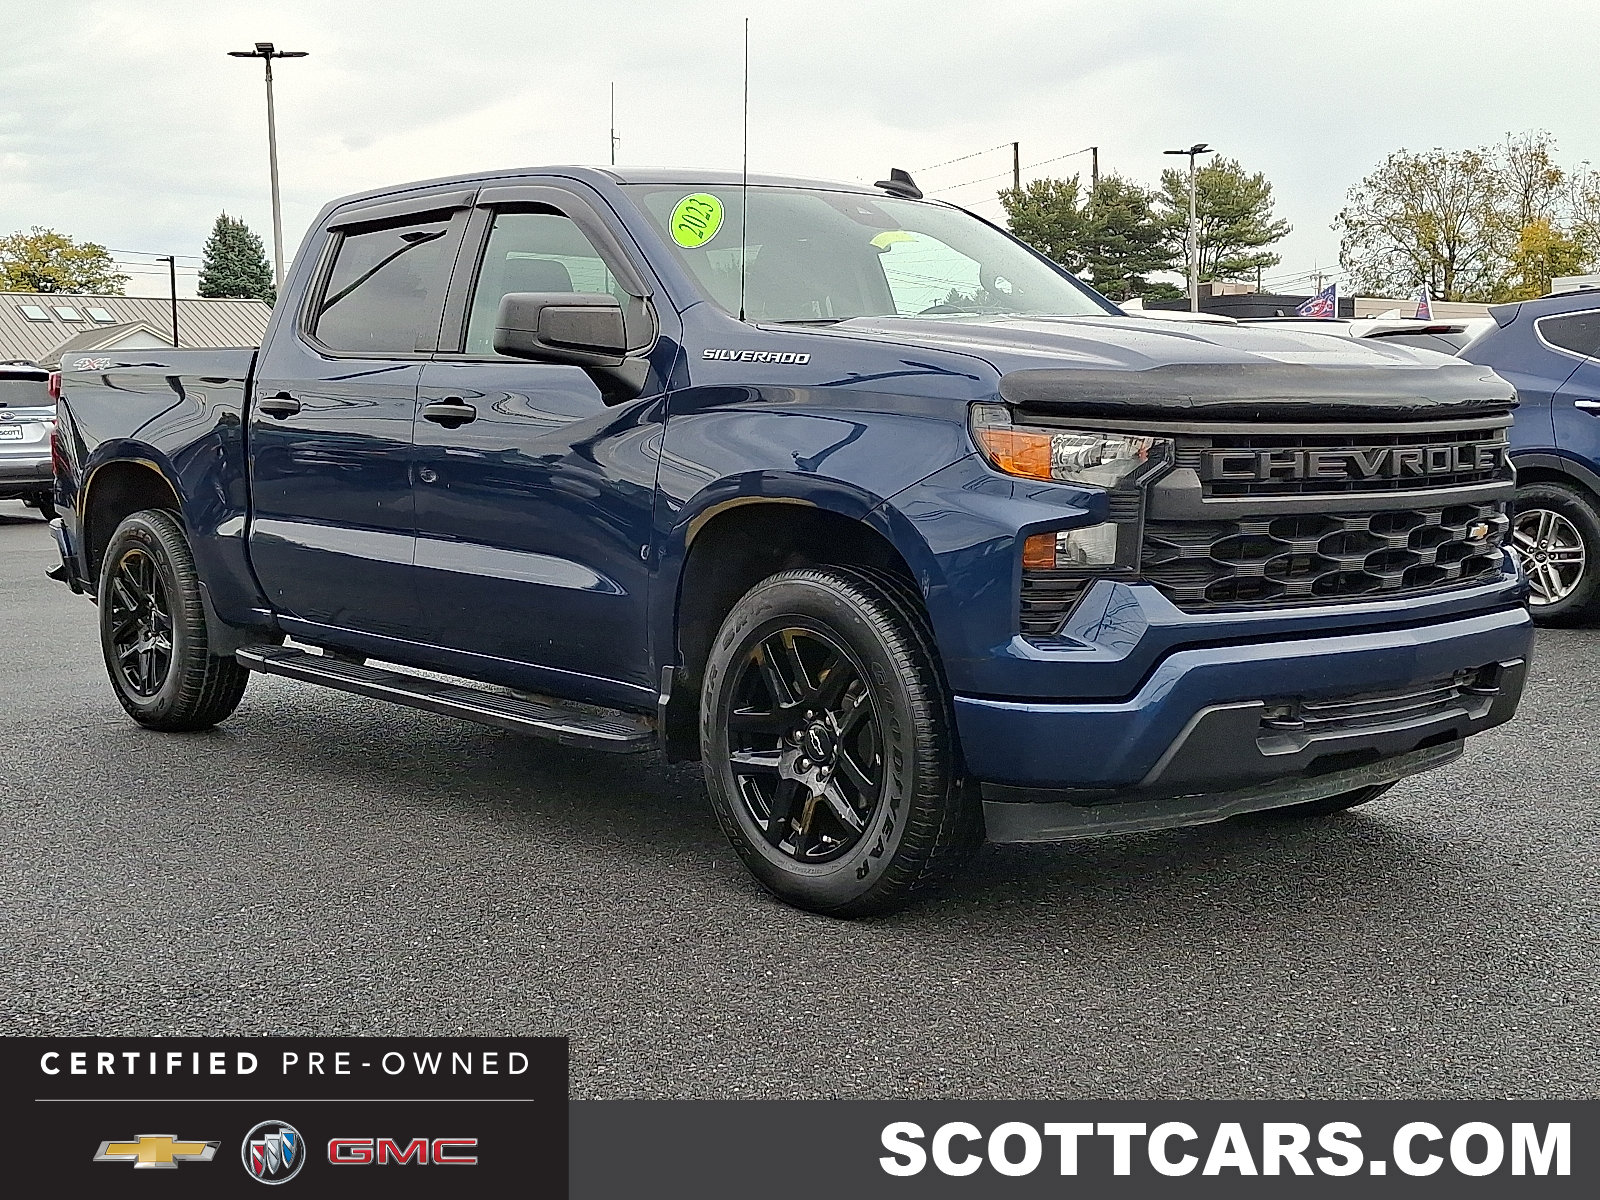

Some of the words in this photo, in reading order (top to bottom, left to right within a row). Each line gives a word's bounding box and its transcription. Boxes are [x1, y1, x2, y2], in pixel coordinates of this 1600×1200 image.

[678, 198, 714, 239] 2023
[702, 348, 811, 365] SILVERADO
[855, 661, 905, 882] GOODYEAR
